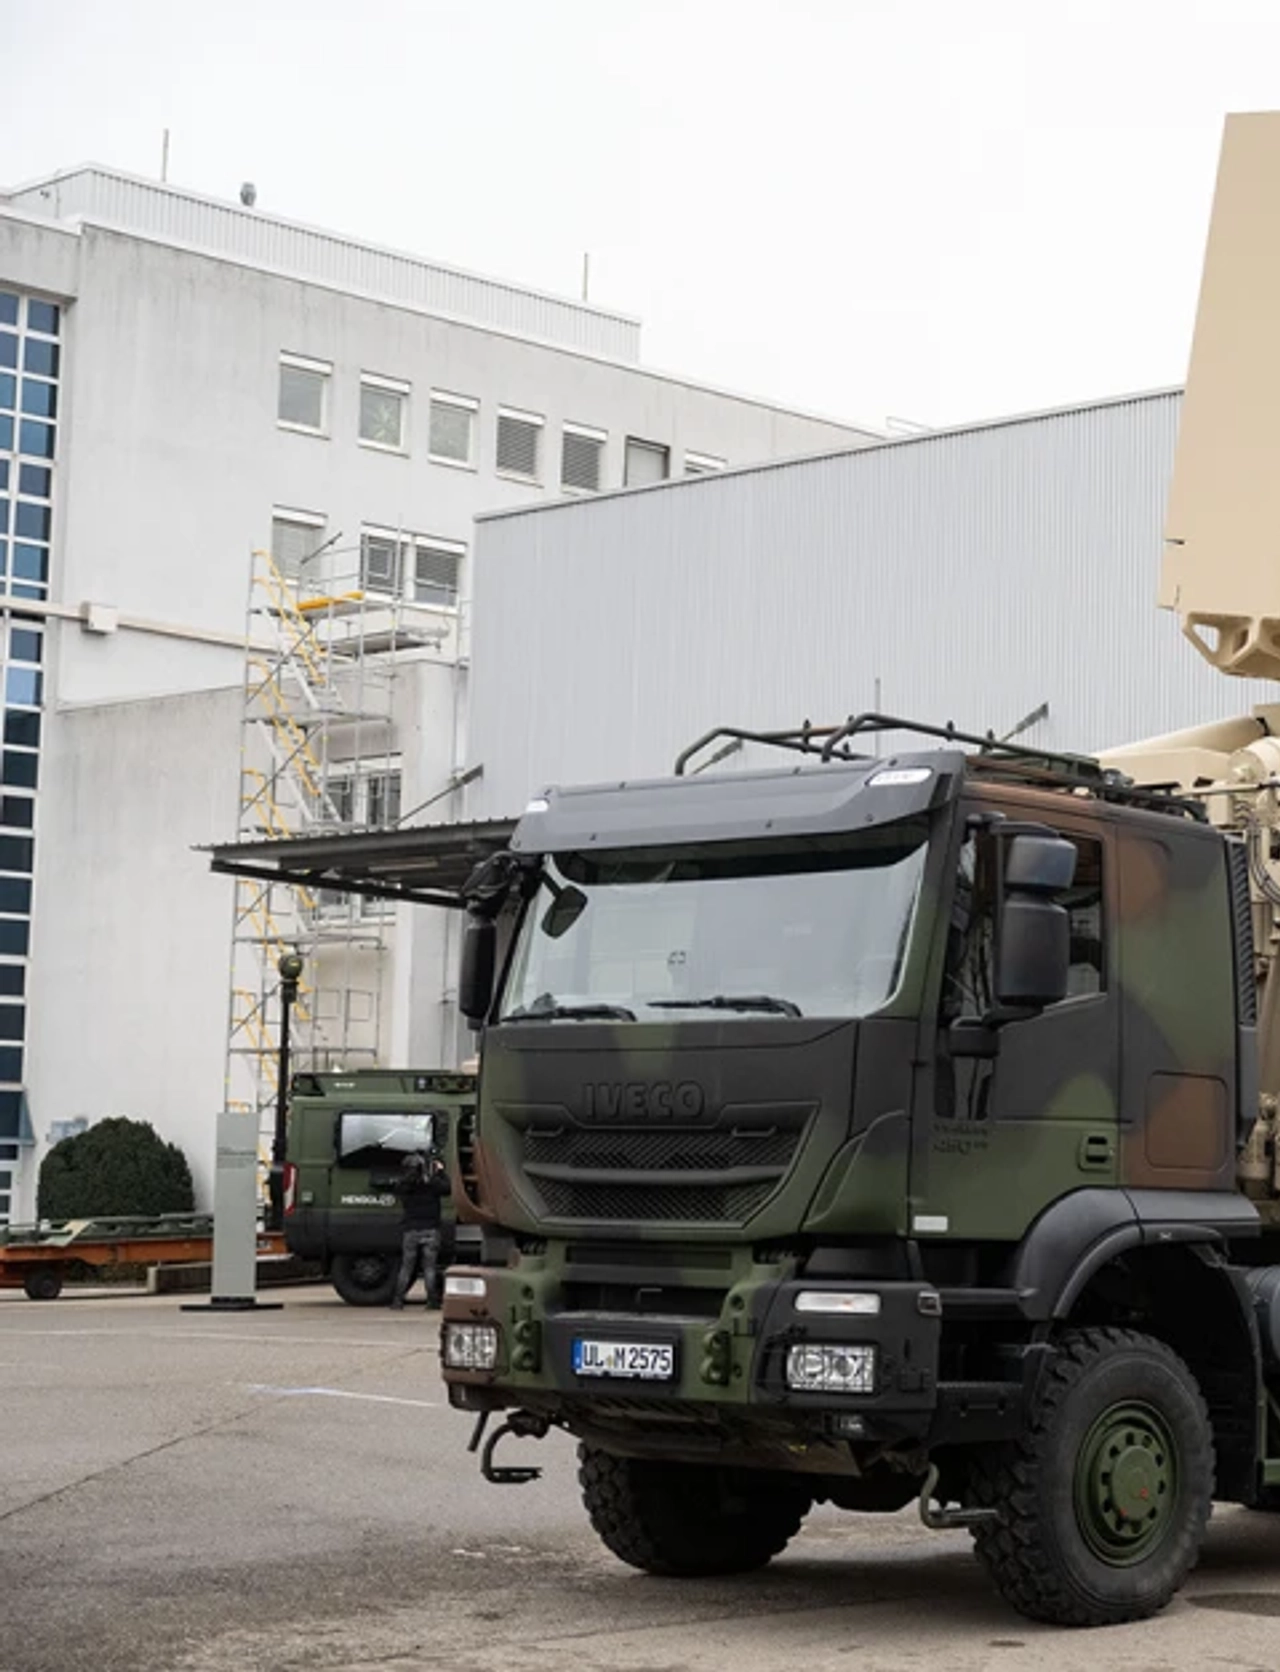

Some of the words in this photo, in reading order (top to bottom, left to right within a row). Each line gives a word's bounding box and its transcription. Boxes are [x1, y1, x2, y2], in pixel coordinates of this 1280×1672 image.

[584, 1081, 705, 1118] IVECO
[583, 1344, 604, 1367] UL
[628, 1346, 672, 1372] 2575
